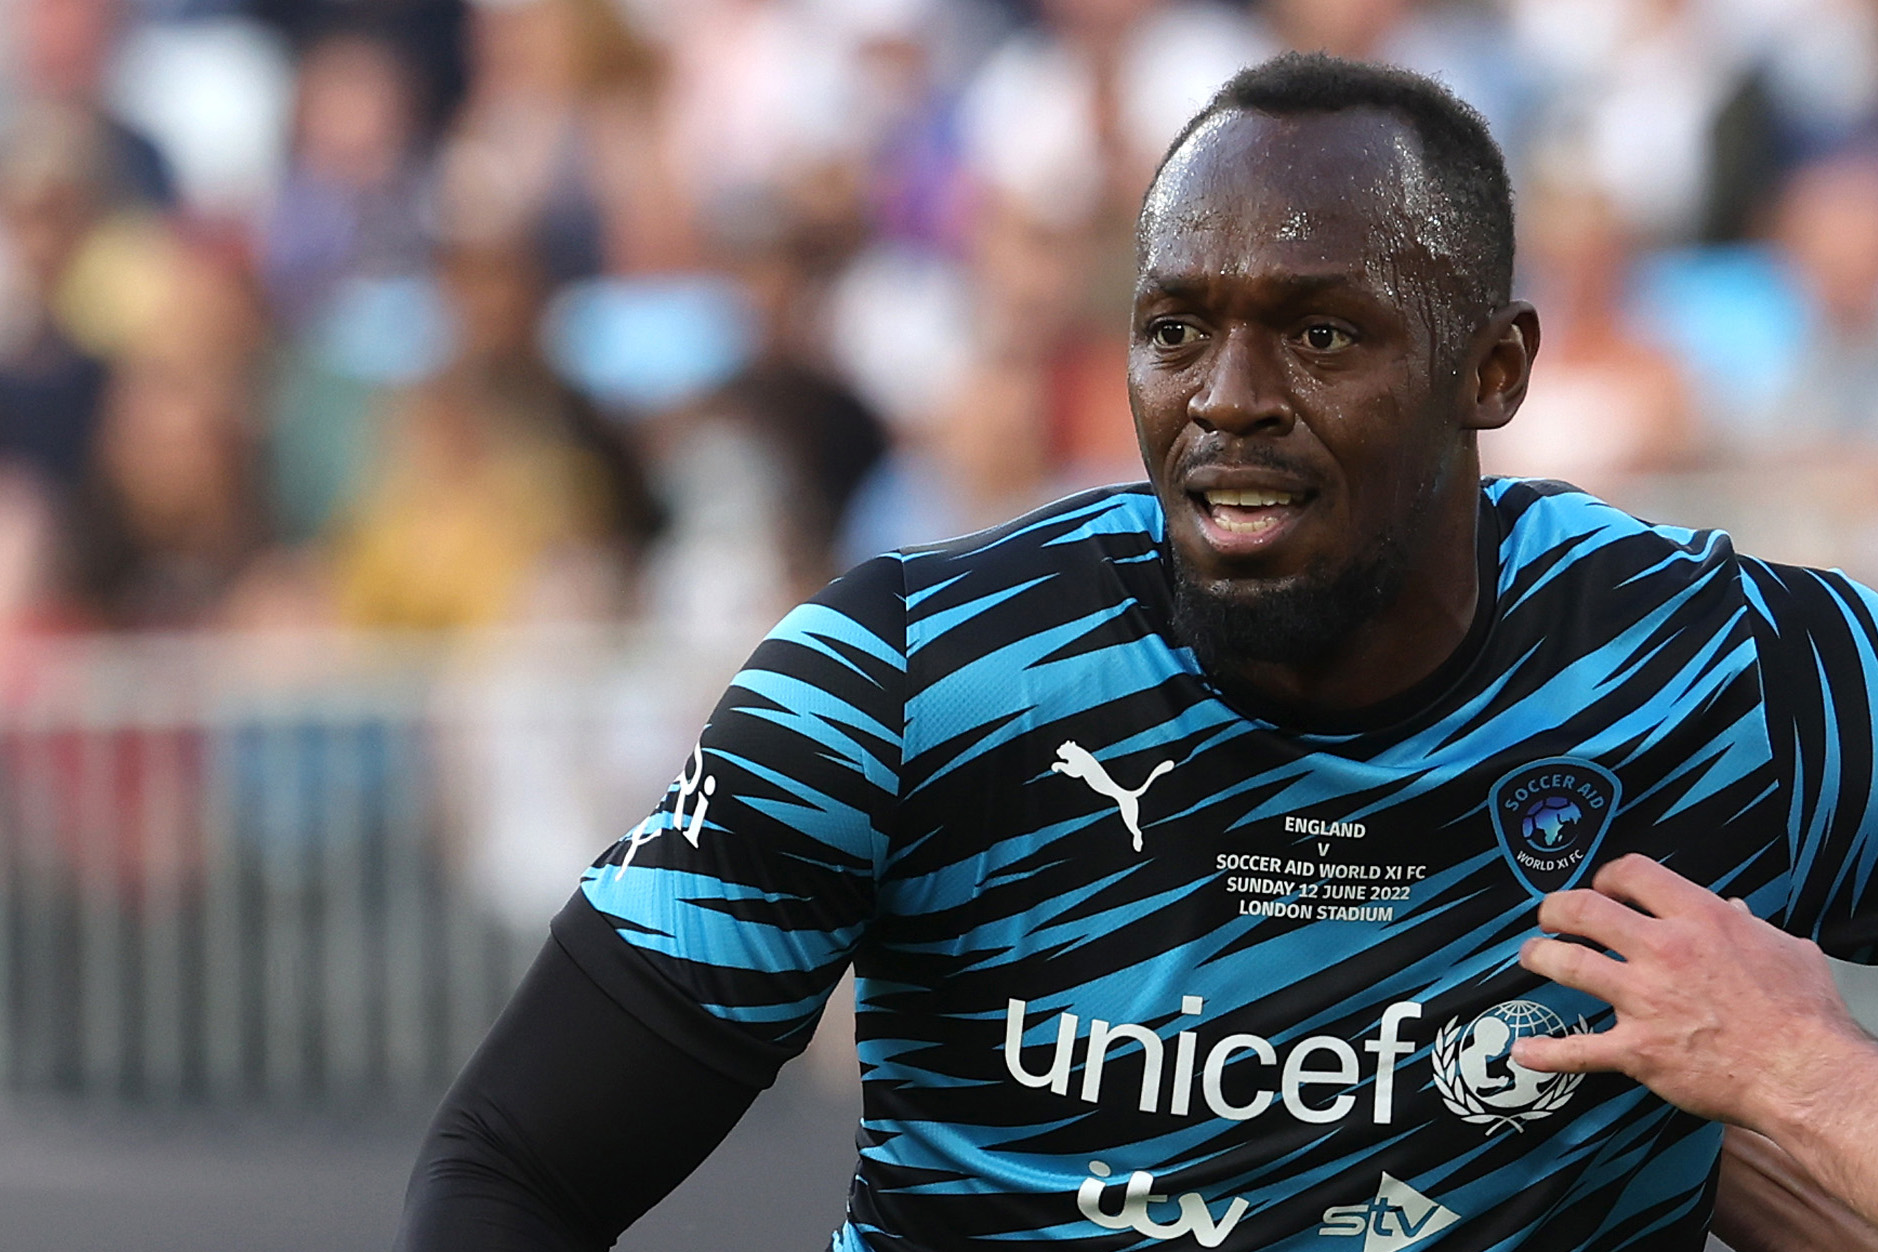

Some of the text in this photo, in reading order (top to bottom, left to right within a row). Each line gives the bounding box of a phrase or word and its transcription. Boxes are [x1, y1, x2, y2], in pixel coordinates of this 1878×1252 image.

[1505, 774, 1604, 812] SOCCER AID
[1285, 816, 1366, 838] ENGLAND
[1318, 842, 1330, 857] V
[1516, 849, 1585, 871] WORLD XI FC
[1216, 854, 1427, 880] SOCCER AID WORLD XI FC
[1226, 877, 1411, 901] SUNDAY 12 JUNE 2022
[1239, 900, 1393, 921] LONDON STADIUM
[1005, 995, 1423, 1124] unicef
[1077, 1160, 1249, 1249] itv
[1318, 1195, 1442, 1239] stv
